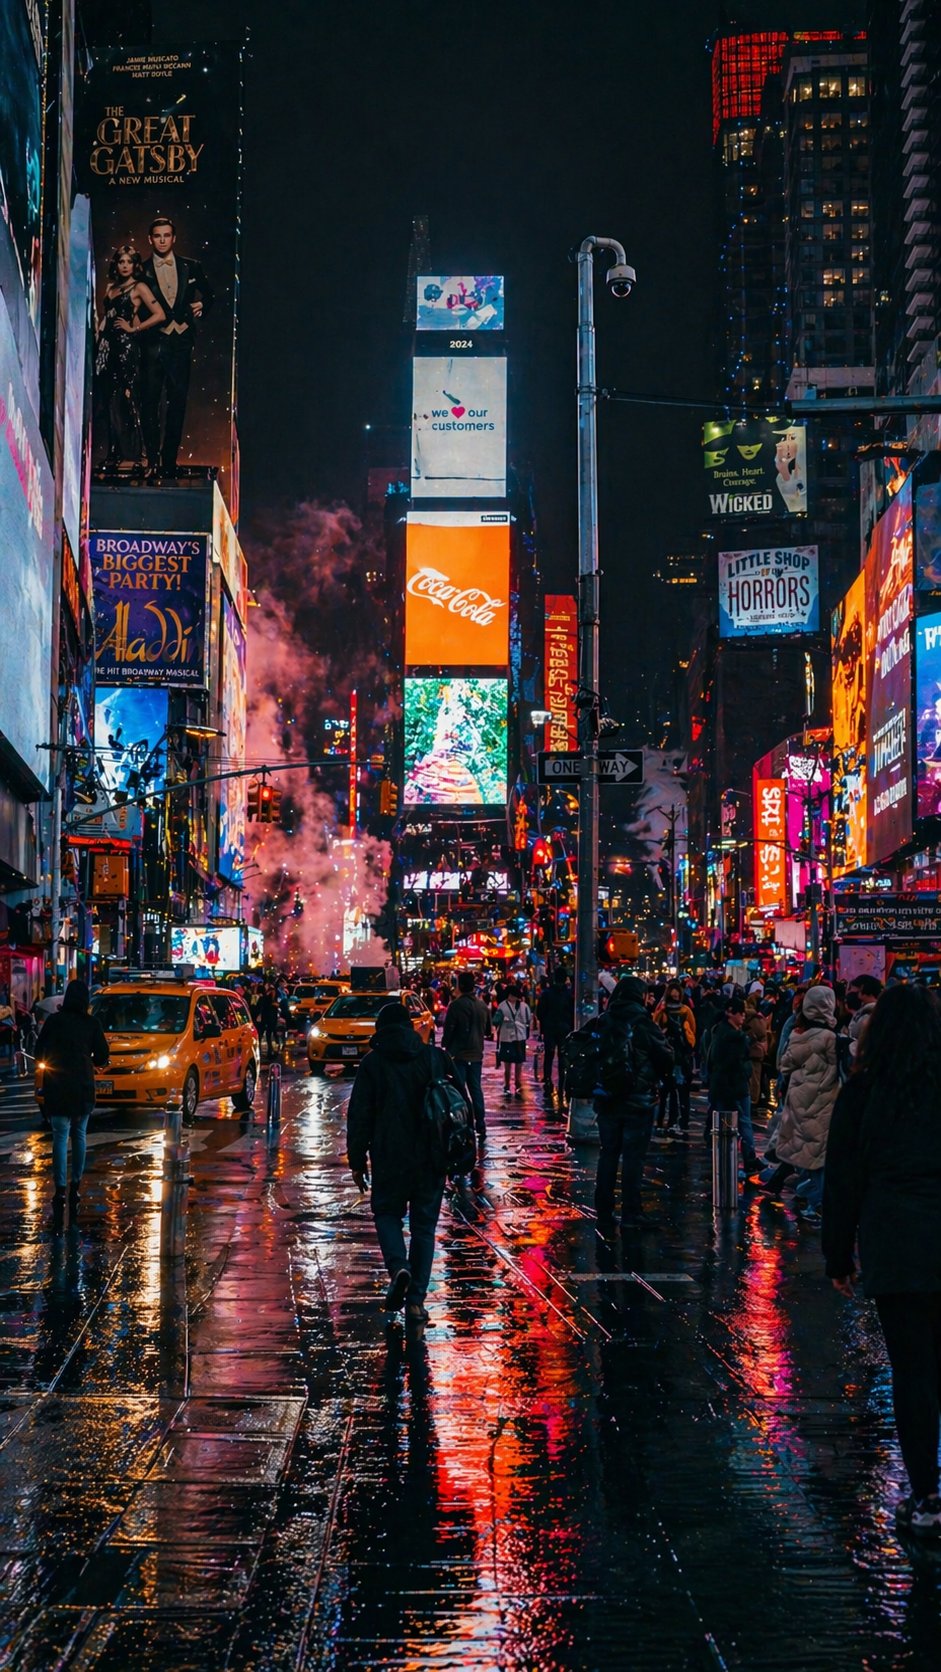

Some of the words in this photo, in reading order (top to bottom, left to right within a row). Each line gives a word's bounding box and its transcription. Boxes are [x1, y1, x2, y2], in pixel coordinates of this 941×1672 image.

[104, 106, 125, 117] THE
[96, 115, 196, 146] GREAT
[89, 144, 205, 175] GATSBY
[109, 177, 117, 185] A
[119, 176, 141, 184] NEW
[143, 175, 184, 184] MUSICAL
[449, 340, 473, 349] 2024
[431, 409, 449, 418] we
[467, 408, 488, 418] our
[431, 421, 495, 431] customers
[96, 539, 200, 555] BROADWAY'S
[103, 554, 191, 573] BIGGEST
[727, 552, 771, 578] LITTLE
[774, 551, 810, 571] SHOP
[108, 572, 181, 591] PARTY!
[727, 575, 810, 617] HORRORS
[552, 762, 580, 774] ONE
[598, 761, 628, 774] WAY
